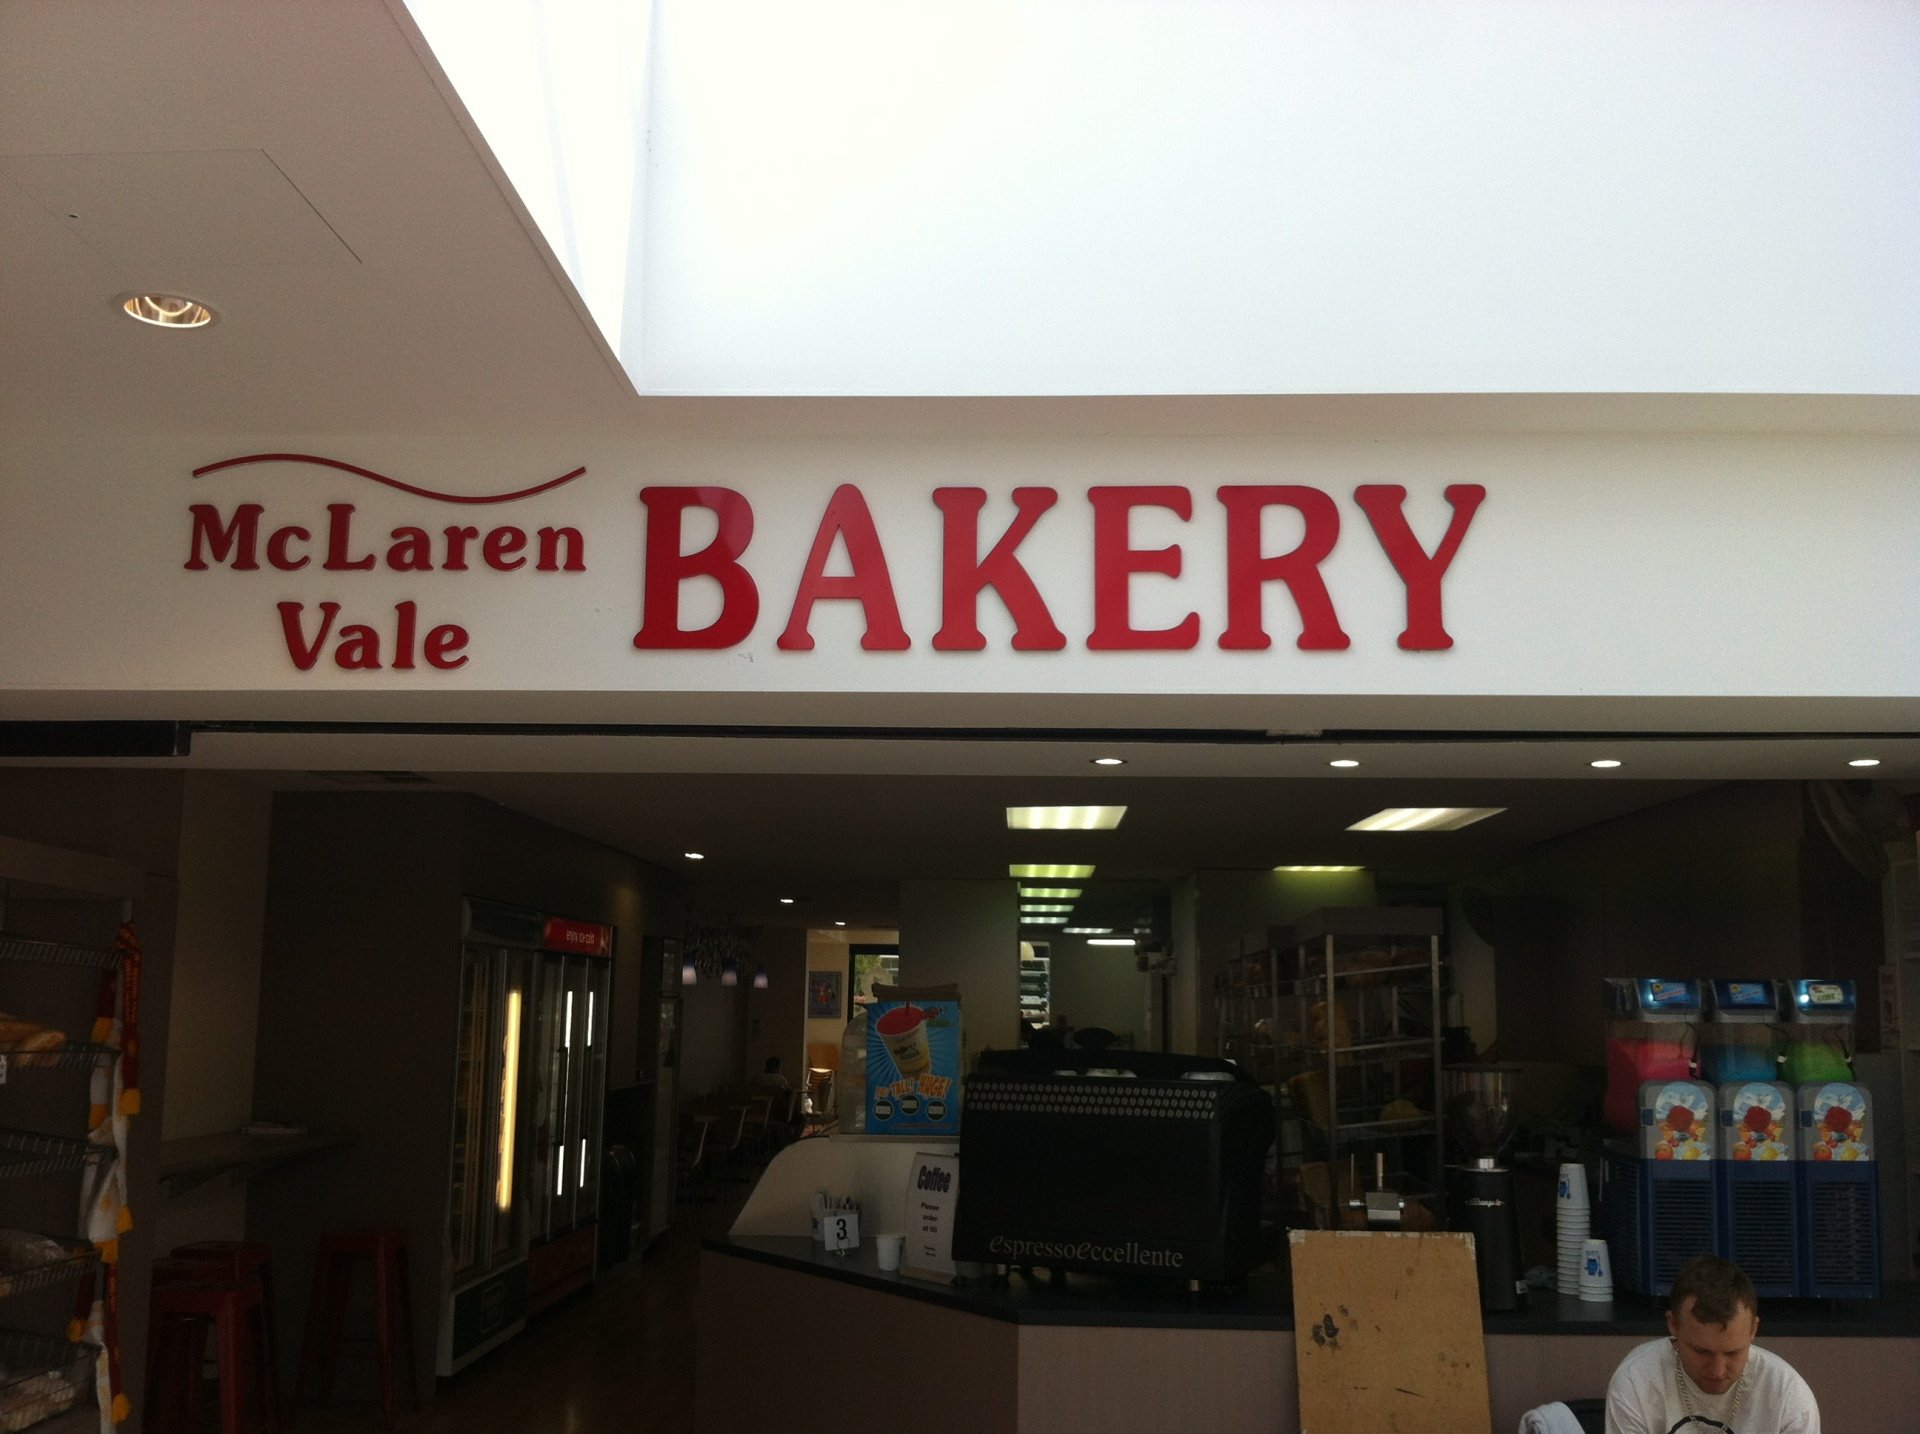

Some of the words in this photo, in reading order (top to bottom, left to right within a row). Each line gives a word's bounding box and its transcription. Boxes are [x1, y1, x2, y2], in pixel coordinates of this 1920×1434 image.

[184, 503, 587, 572] McLaren
[634, 482, 1486, 651] BAKERY
[276, 600, 470, 672] Vale
[917, 1165, 951, 1193] Coffee
[921, 1202, 940, 1212] Please
[836, 1218, 847, 1240] 3
[989, 1234, 1184, 1268] espressoeccellente
